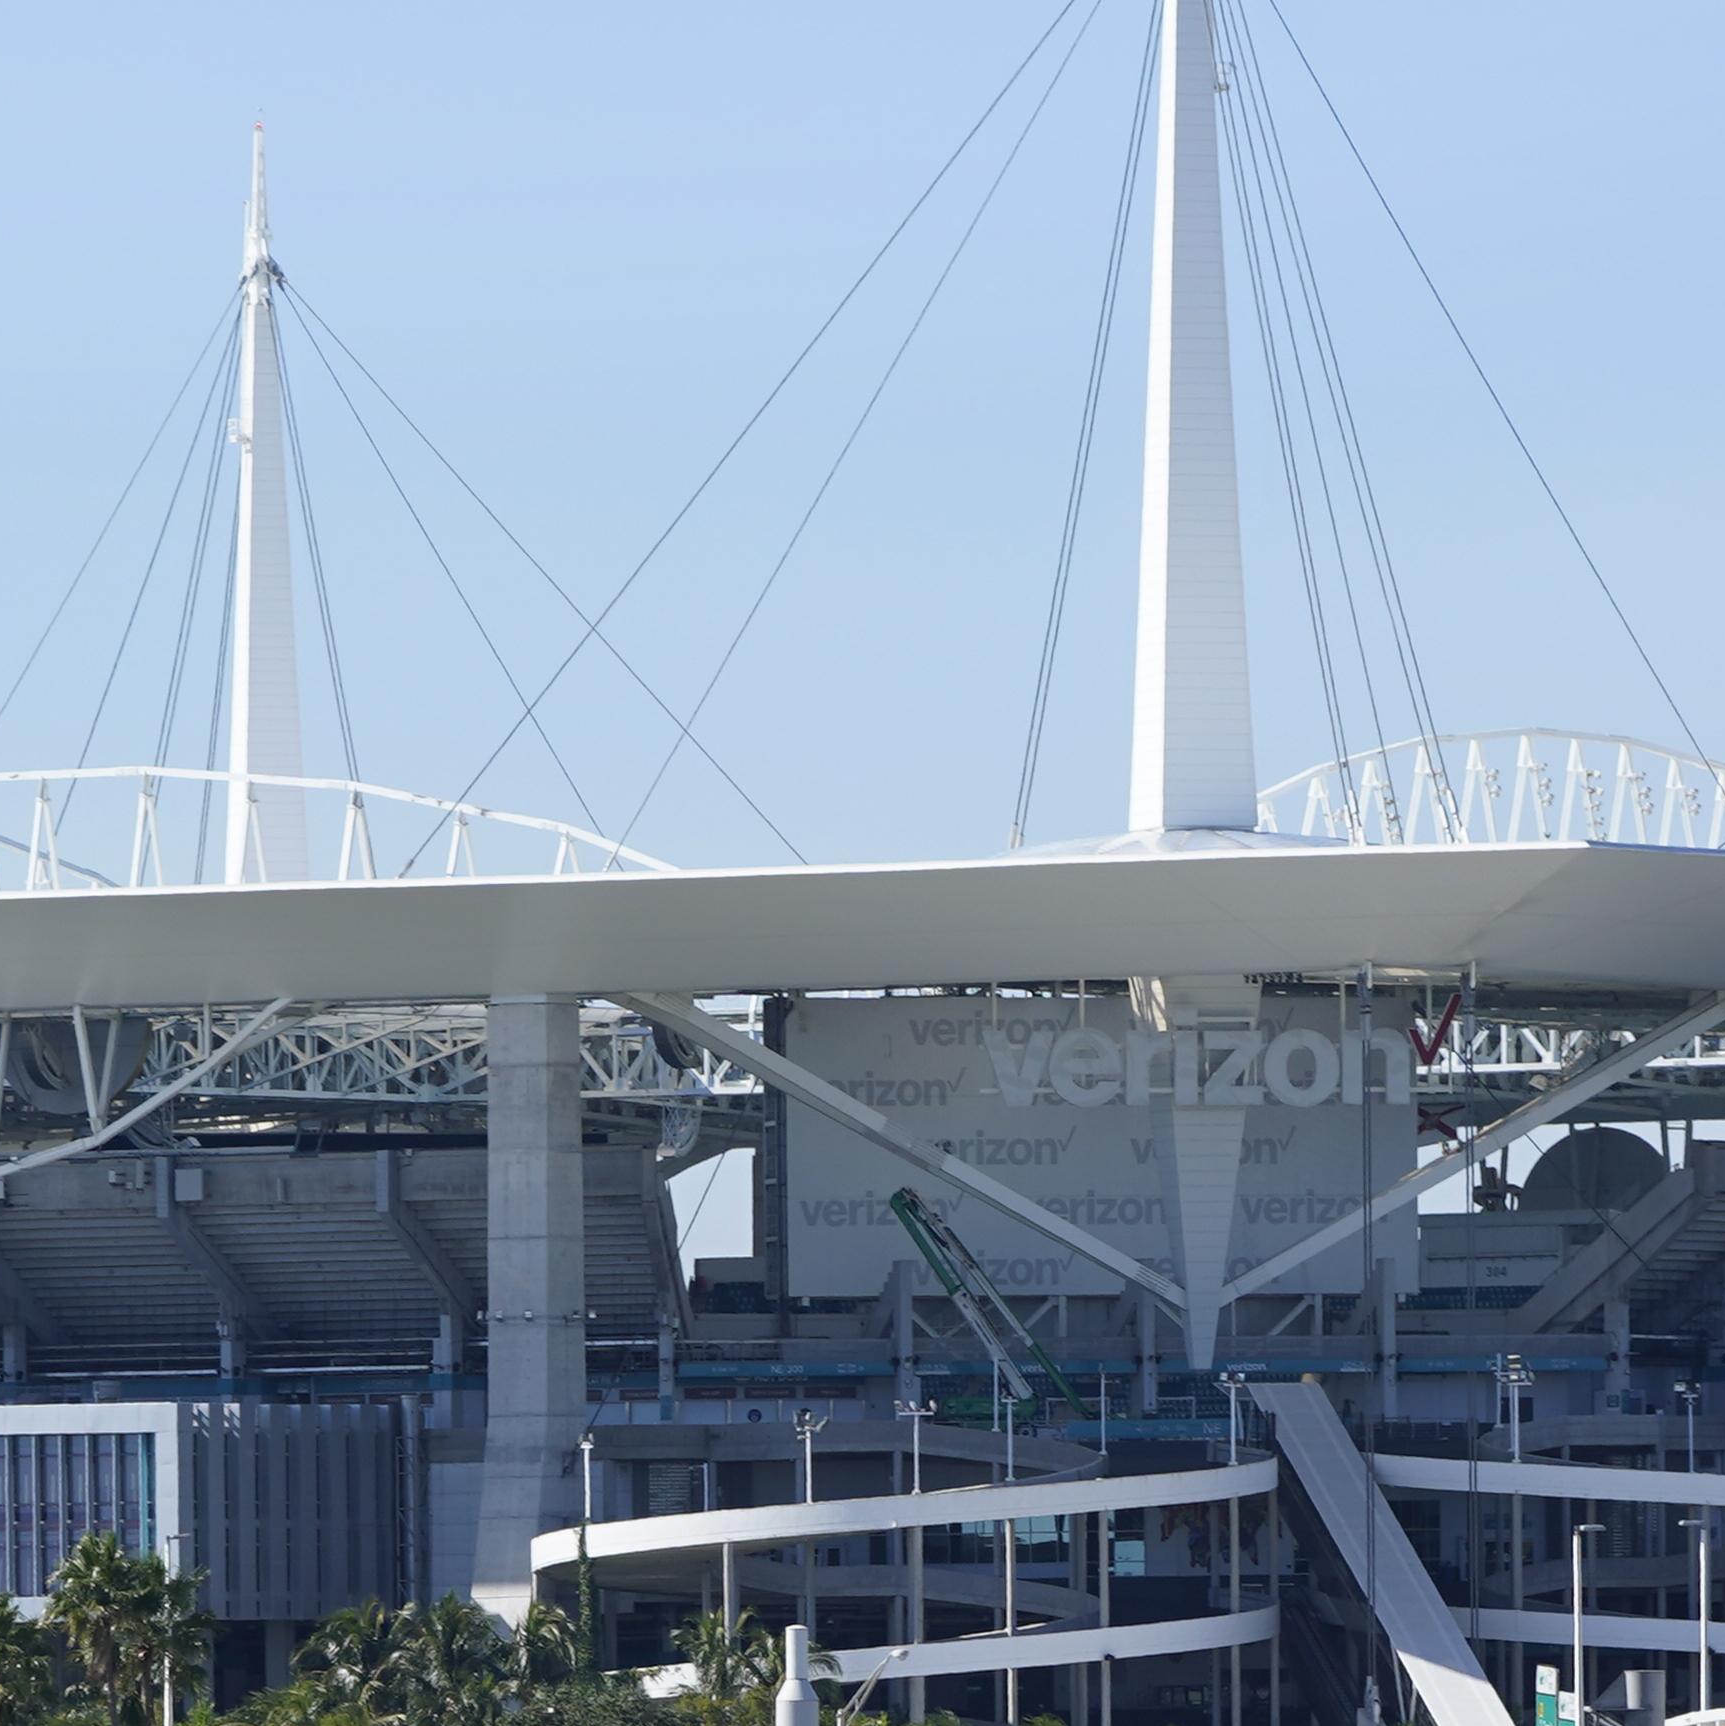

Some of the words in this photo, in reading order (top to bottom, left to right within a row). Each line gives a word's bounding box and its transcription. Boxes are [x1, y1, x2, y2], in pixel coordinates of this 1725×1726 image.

[981, 1009, 1410, 1106] verizon
[829, 1072, 947, 1106] rizon
[1486, 1266, 1508, 1278] 304
